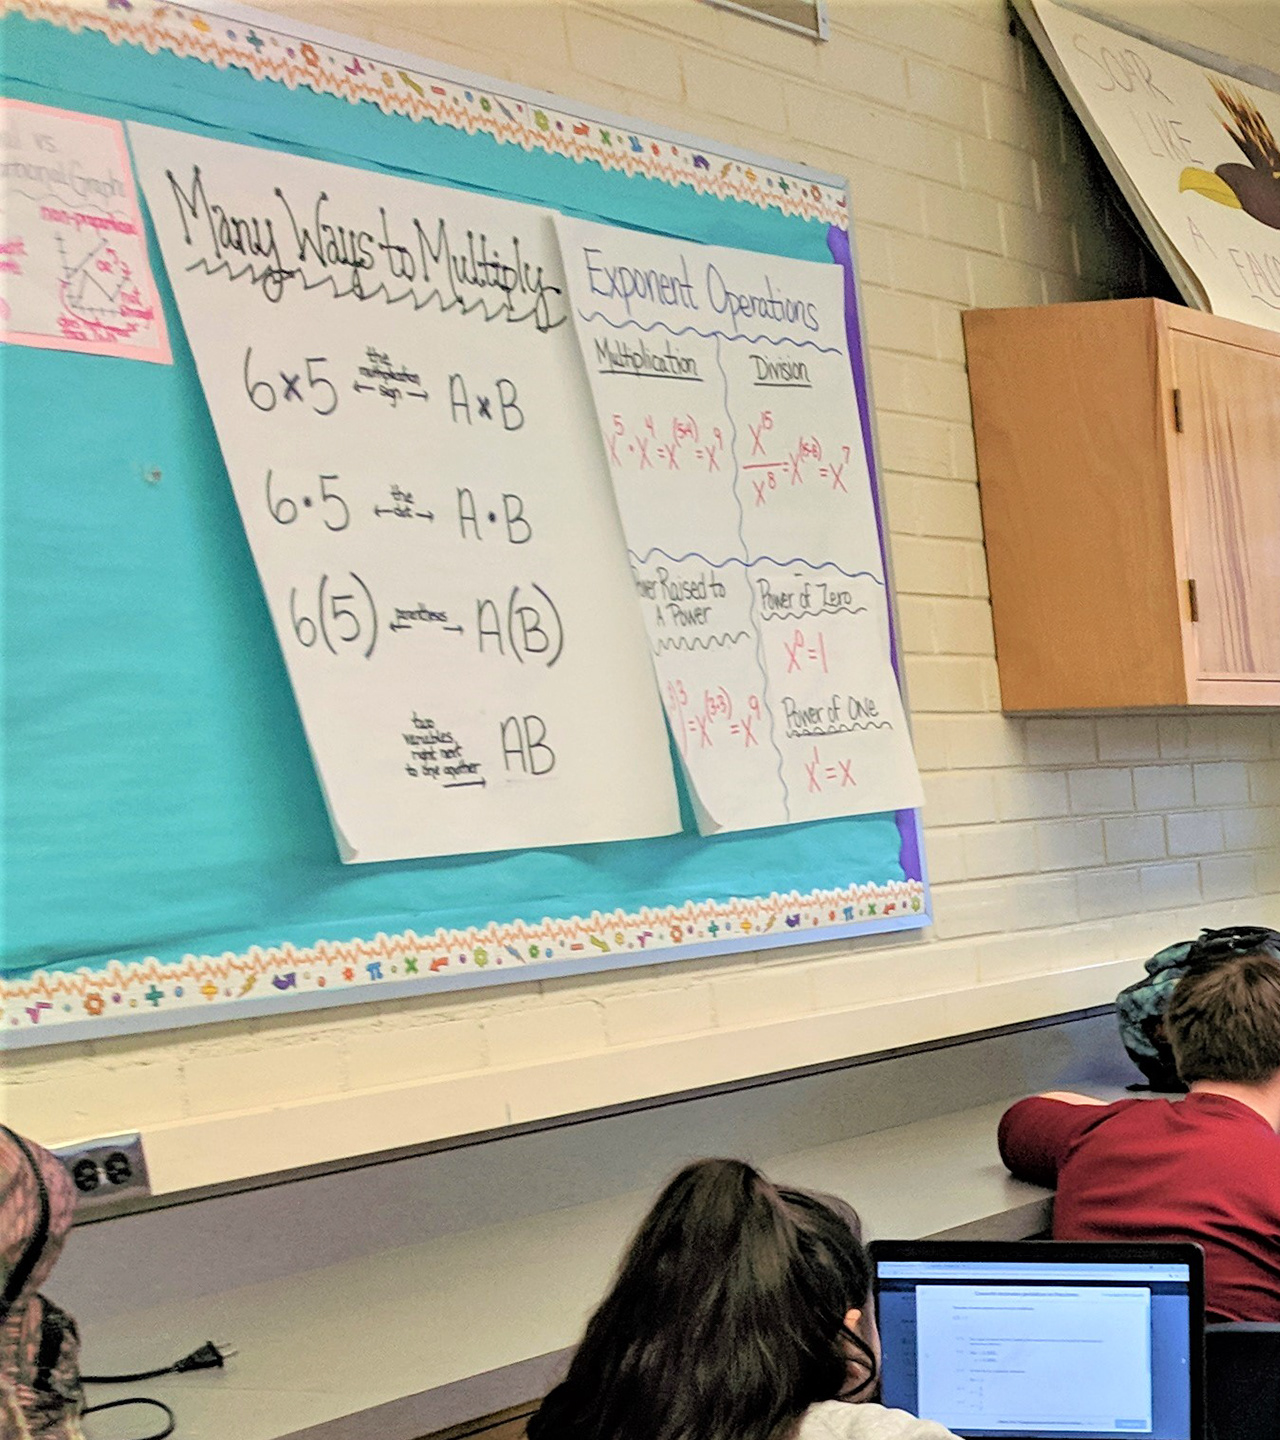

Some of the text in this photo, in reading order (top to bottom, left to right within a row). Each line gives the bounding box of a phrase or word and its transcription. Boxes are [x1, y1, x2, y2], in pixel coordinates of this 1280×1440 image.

[1072, 33, 1175, 104] SOAR
[1130, 106, 1204, 165] LIKE
[165, 163, 562, 332] Many Ways to Multiply
[582, 247, 819, 332] Exponent Operations
[594, 338, 698, 378] Multiplication
[749, 355, 811, 382] Division
[656, 566, 707, 601] Raised
[709, 569, 727, 599] to
[756, 578, 853, 611] Power of Zero
[666, 603, 712, 627] Power
[782, 696, 824, 729] Power
[825, 694, 842, 722] of
[500, 715, 556, 776] AB
